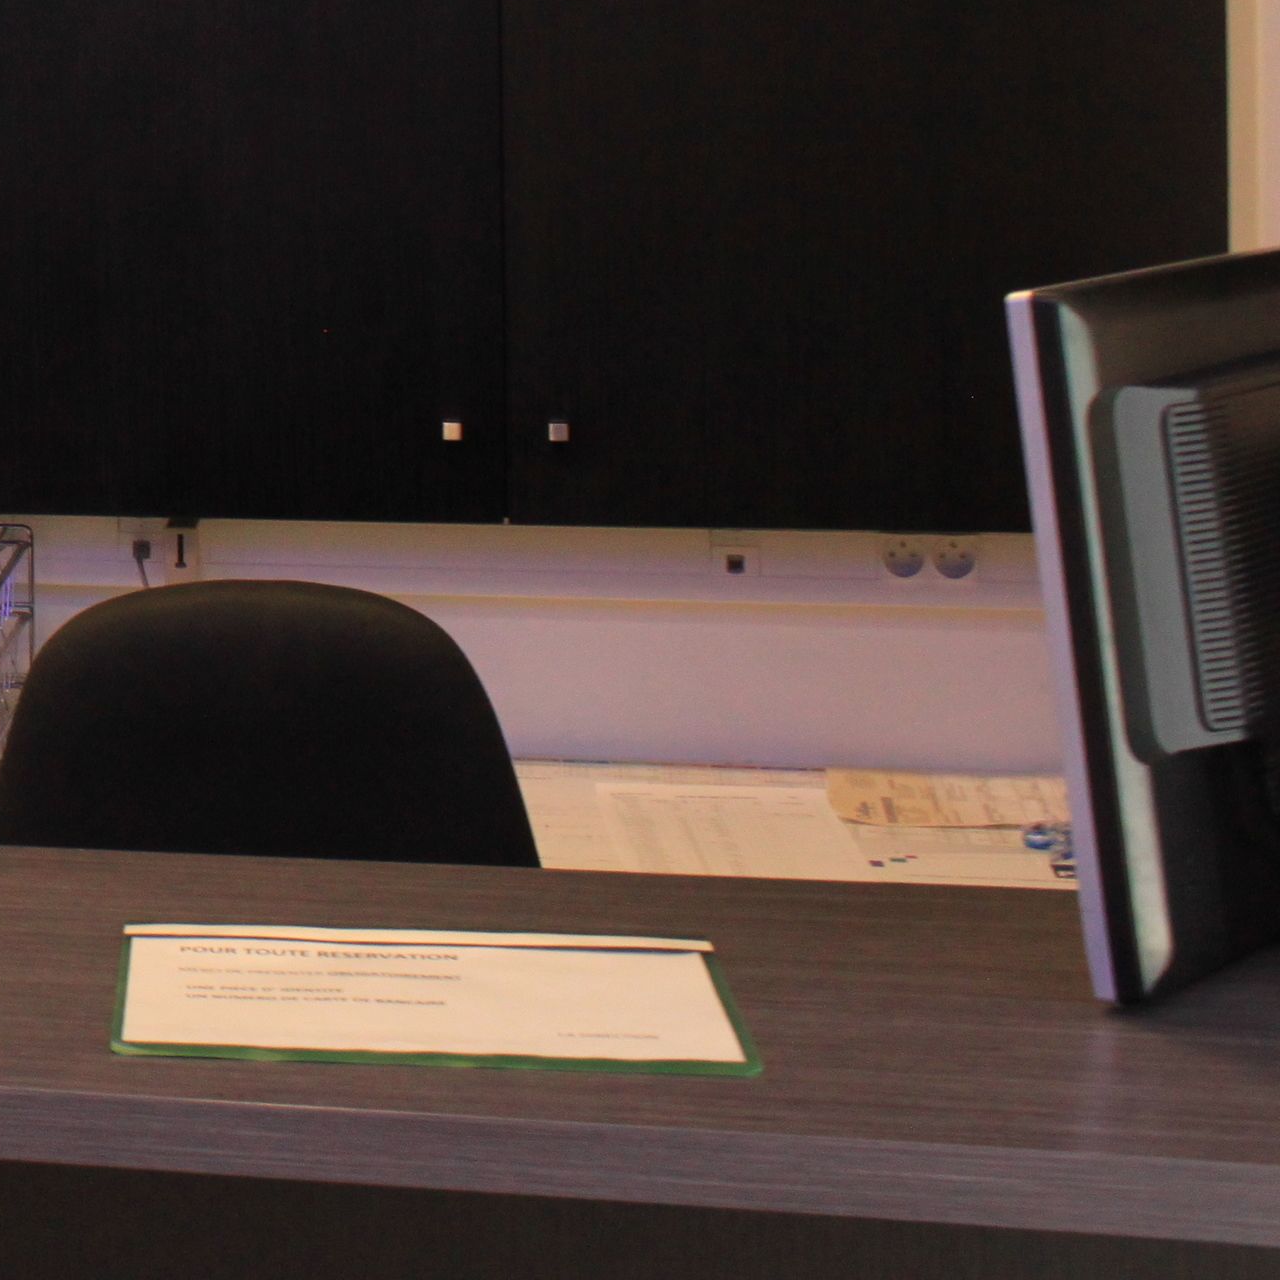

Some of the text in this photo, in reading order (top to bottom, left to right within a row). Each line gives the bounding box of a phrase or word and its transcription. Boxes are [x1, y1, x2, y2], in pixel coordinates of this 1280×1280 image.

[180, 945, 459, 961] POUR TOUTE RESERVATION
